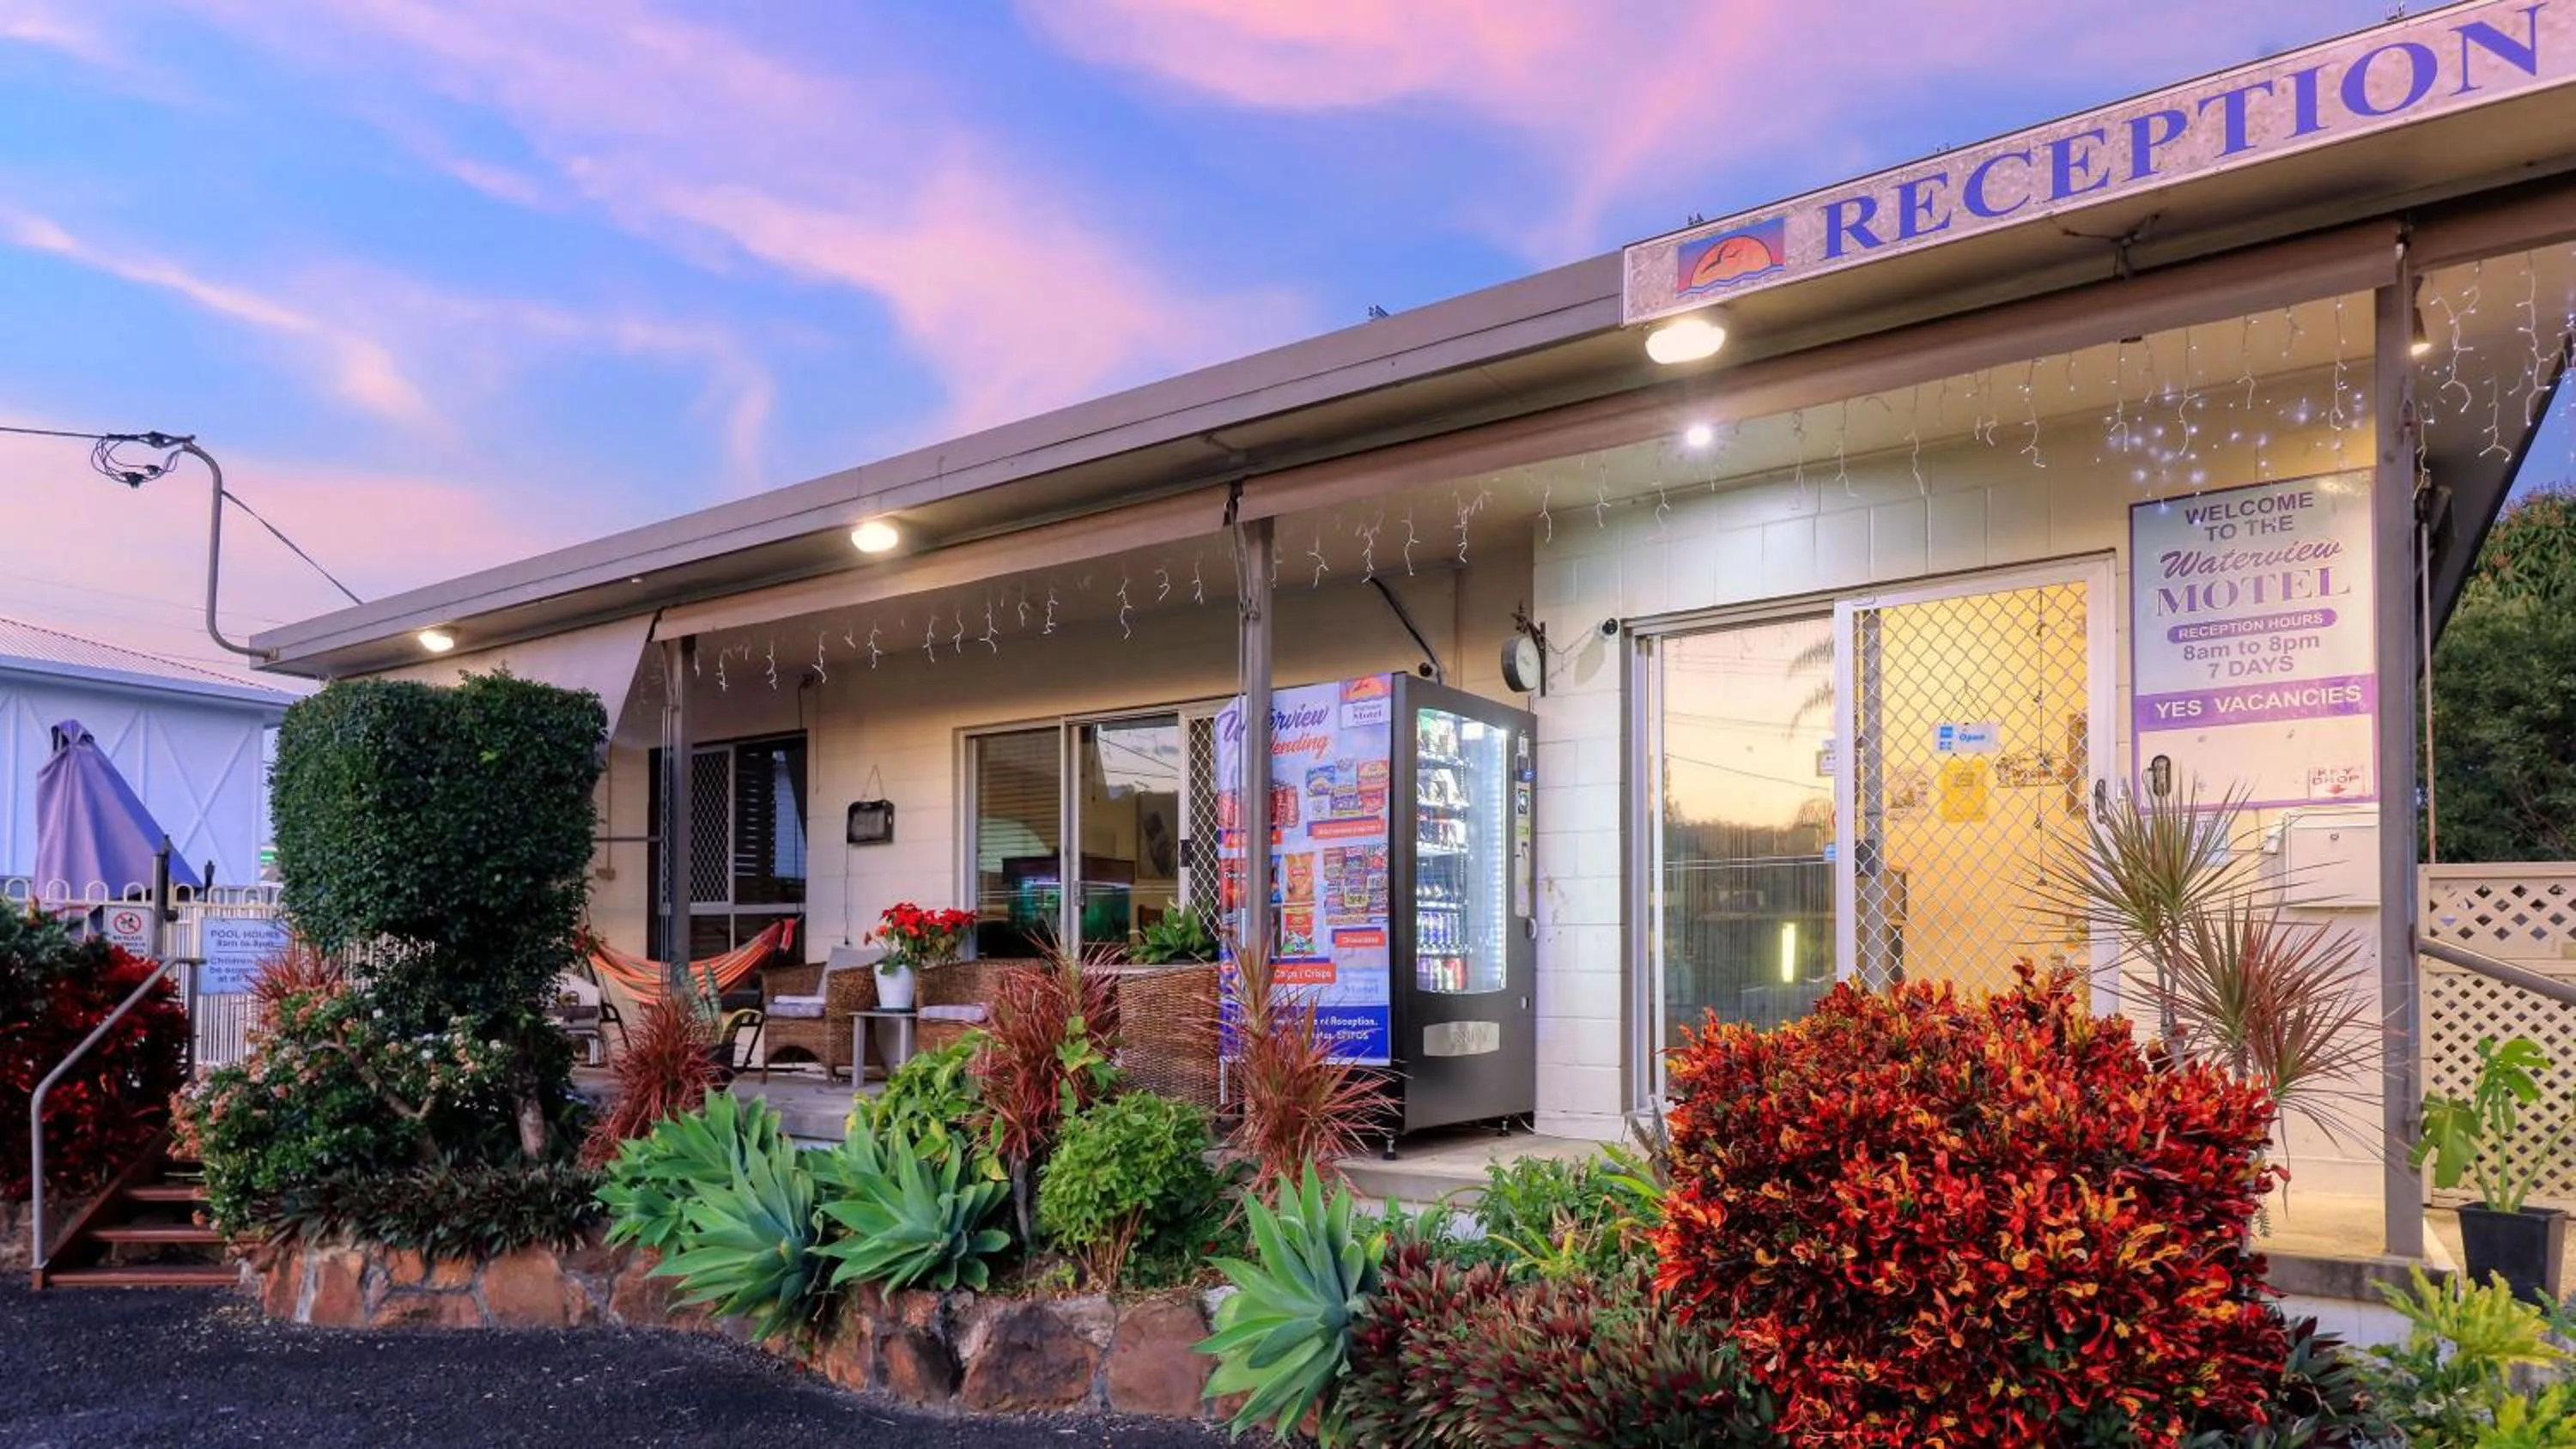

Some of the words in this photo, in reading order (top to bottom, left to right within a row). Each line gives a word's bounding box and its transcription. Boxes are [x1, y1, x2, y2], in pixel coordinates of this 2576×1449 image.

[1819, 3, 2548, 263] RECEPTION
[2184, 491, 2314, 525] WELCOME
[2204, 523, 2237, 543] TO
[2246, 514, 2294, 537] THE
[2160, 538, 2343, 579] Waterview
[2156, 566, 2351, 616] MOTEL
[2178, 620, 2264, 640] RECEPTION
[2268, 613, 2324, 632] HOURS
[2183, 643, 2231, 661] 8am
[2239, 639, 2261, 656] to
[2269, 634, 2320, 658] 8pm
[2208, 663, 2220, 679] 7
[2228, 656, 2294, 677] DAYS
[2155, 700, 2202, 719] YES
[2214, 685, 2361, 714] VACANCIES
[210, 930, 240, 938] POOL
